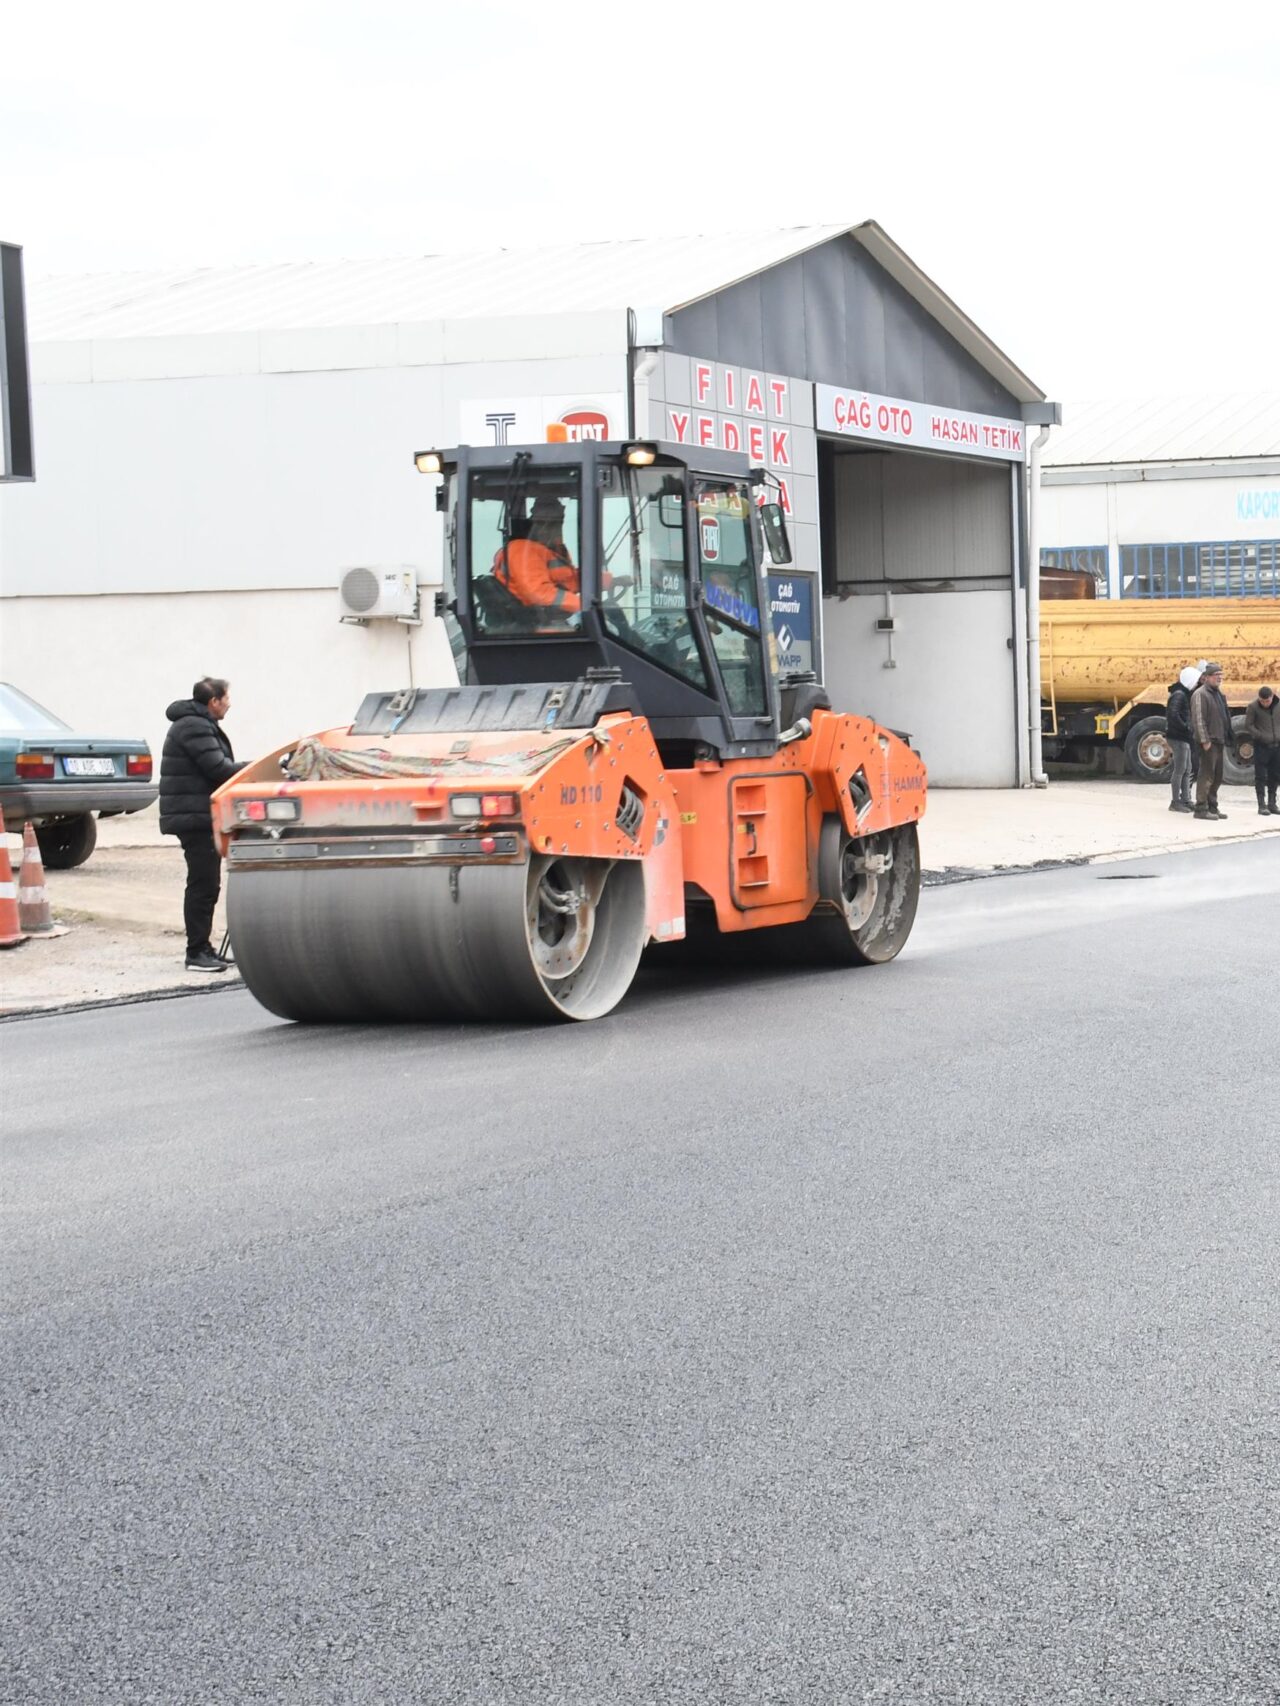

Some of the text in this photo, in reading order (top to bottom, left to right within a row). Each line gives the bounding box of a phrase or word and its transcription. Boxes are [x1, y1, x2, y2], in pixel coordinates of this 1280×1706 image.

[697, 366, 787, 416] FIAT
[834, 396, 1022, 451] ÇAĞ OTO HASAN TETİK
[671, 412, 789, 465] YEDEK
[778, 583, 793, 600] ÇAĞ
[770, 600, 801, 613] OTOMOTİV
[893, 775, 923, 791] HAMM
[560, 784, 602, 805] HD 110
